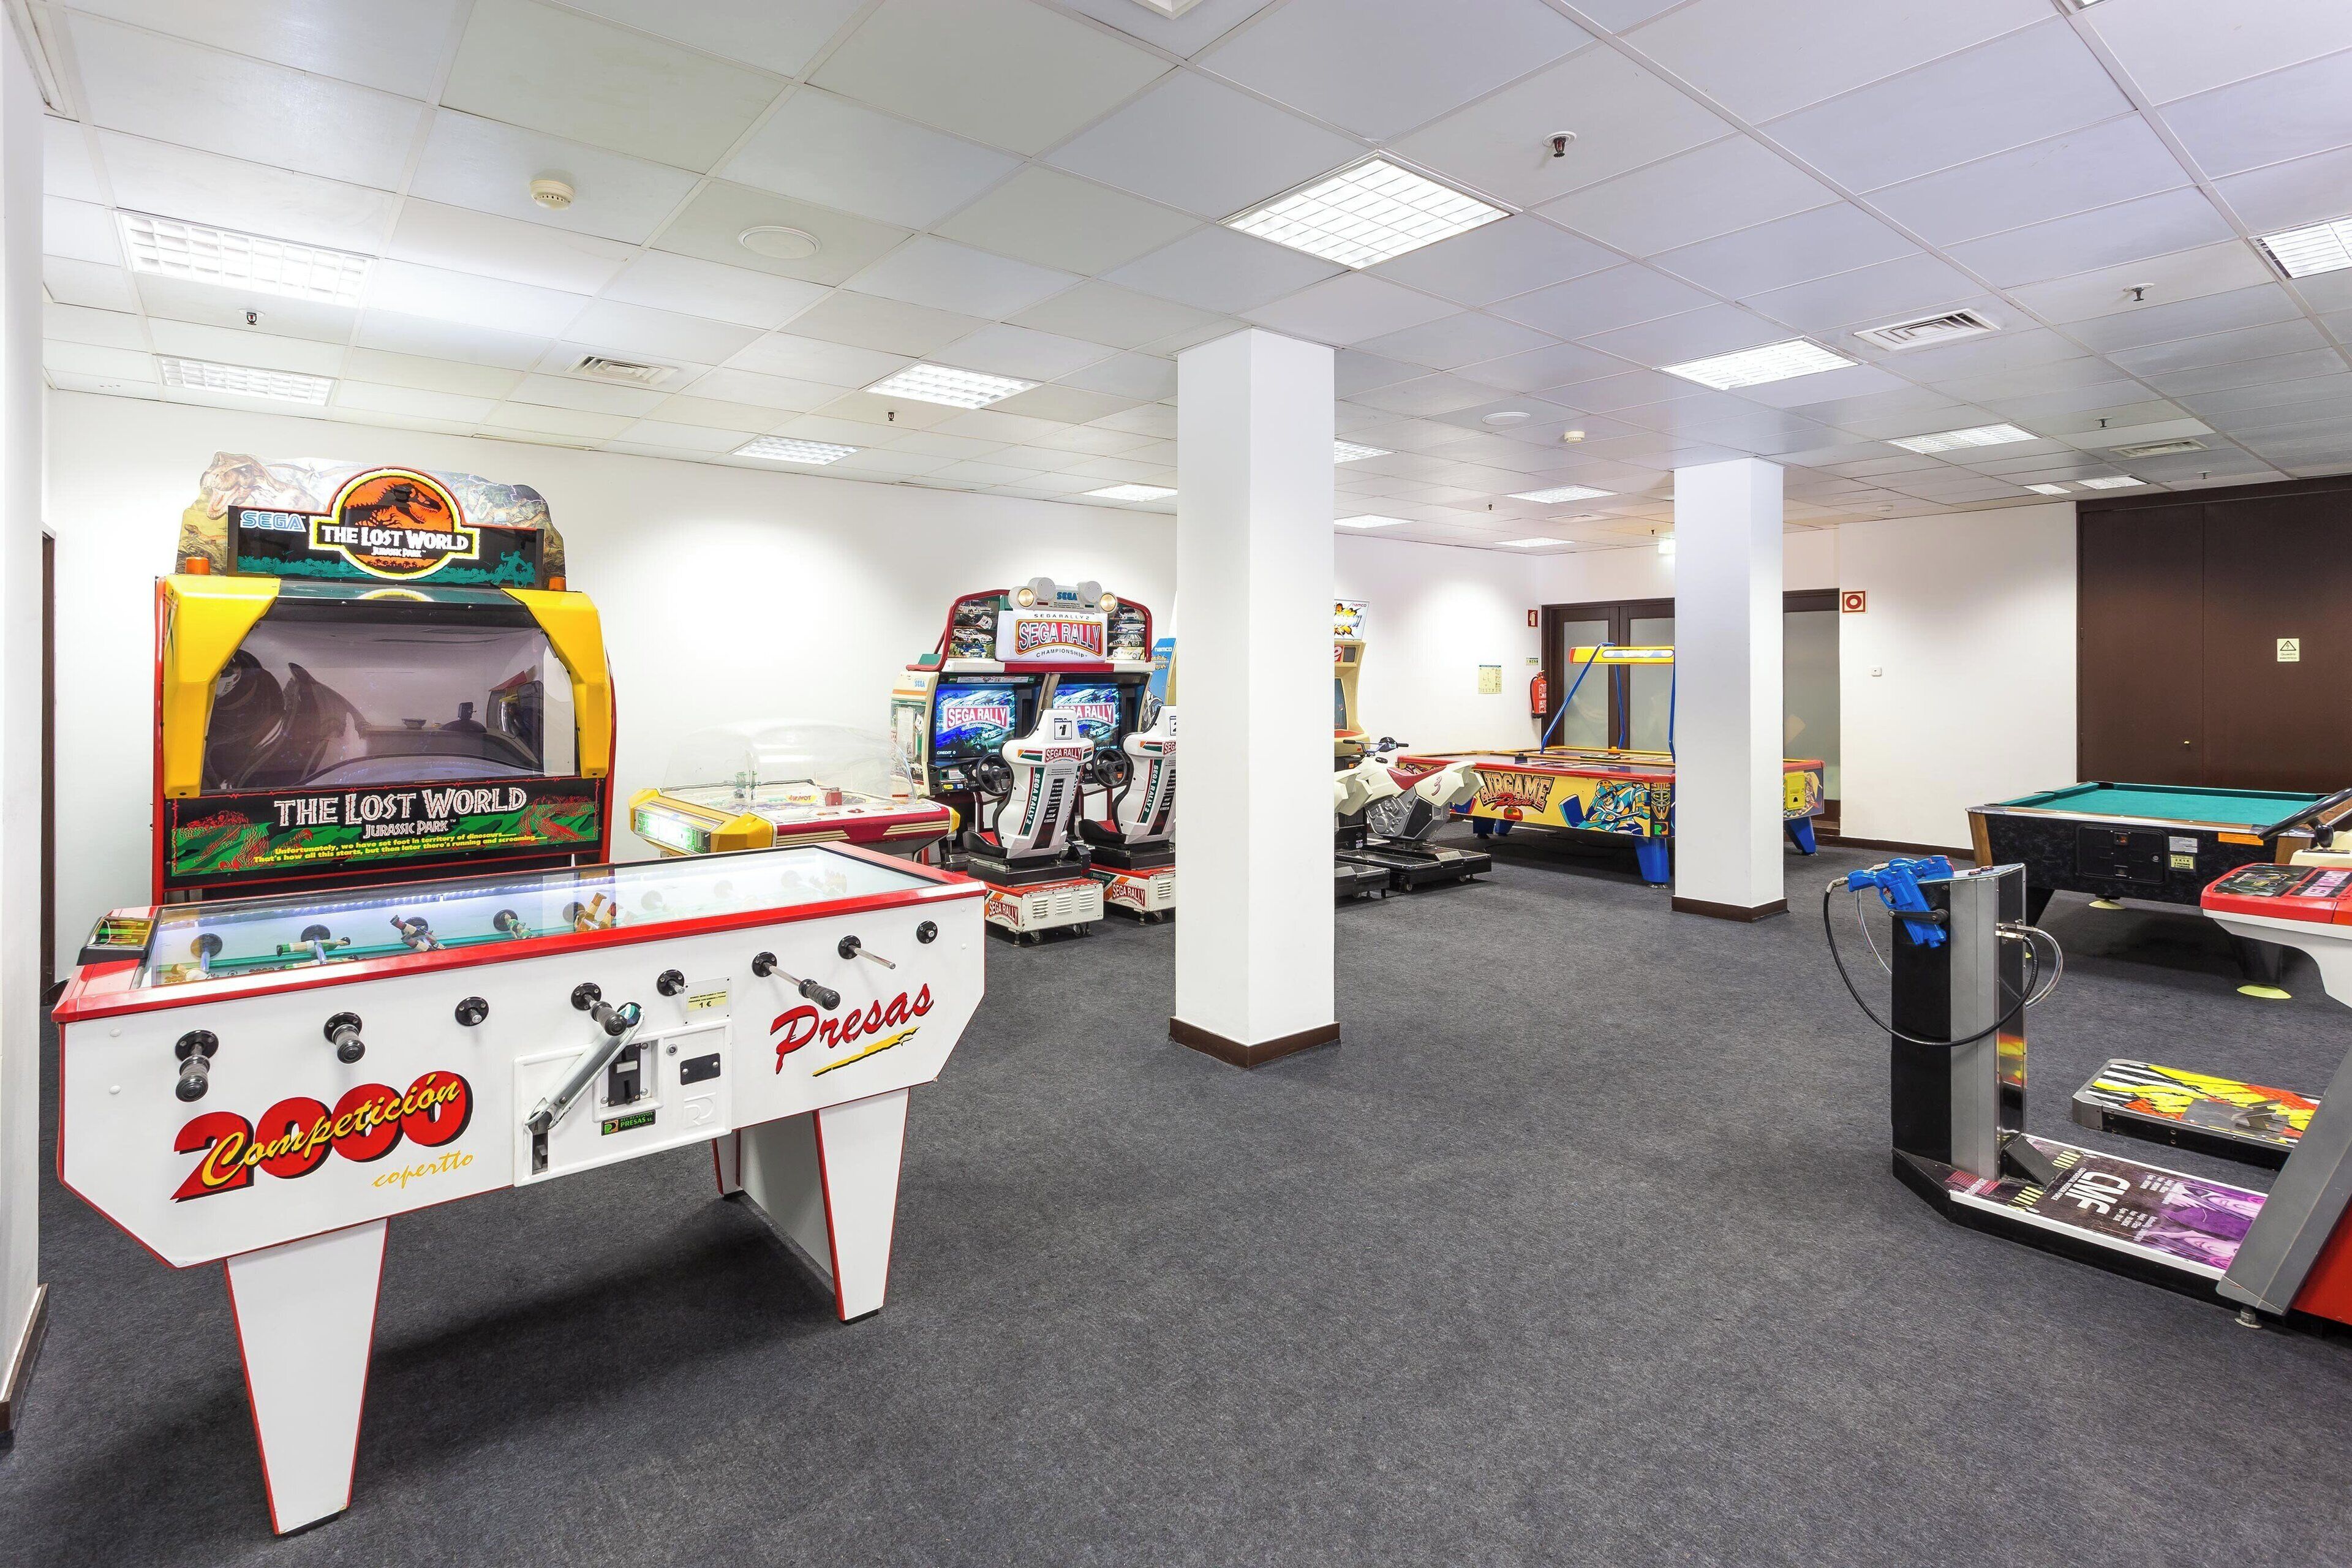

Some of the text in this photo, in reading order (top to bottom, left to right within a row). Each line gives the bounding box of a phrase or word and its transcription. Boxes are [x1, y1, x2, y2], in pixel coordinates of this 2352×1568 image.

[241, 511, 306, 532] SEGA
[322, 526, 469, 551] THE LOST WORLD
[402, 548, 423, 558] PARK
[1057, 592, 1078, 600] SEGA
[1019, 622, 1101, 652] SEGA RALLY
[1036, 649, 1084, 658] CHAMPIONSHIP
[948, 707, 1007, 728] SEGA RALLY
[1085, 704, 1113, 723] RALLY
[1060, 725, 1066, 735] 1
[1046, 748, 1082, 761] SEGA RALLY
[1164, 742, 1176, 754] SEG
[1431, 776, 1442, 796] 3
[274, 788, 527, 826] THE LOST WORLD
[1028, 795, 1038, 820] RALLY
[1147, 786, 1156, 808] RALLY
[363, 820, 448, 839] JURASSIC PARK
[275, 844, 339, 855] Unfortunately,
[1112, 884, 1145, 905] SEGA RALLY
[989, 900, 1018, 924] SEGA RALLY
[770, 983, 934, 1075] Presas
[620, 1112, 653, 1121] RECREATIVOS
[620, 1117, 646, 1128] PRESAS
[170, 1070, 474, 1204] 2000
[202, 1074, 461, 1187] Competición
[2065, 1171, 2130, 1215] CMF
